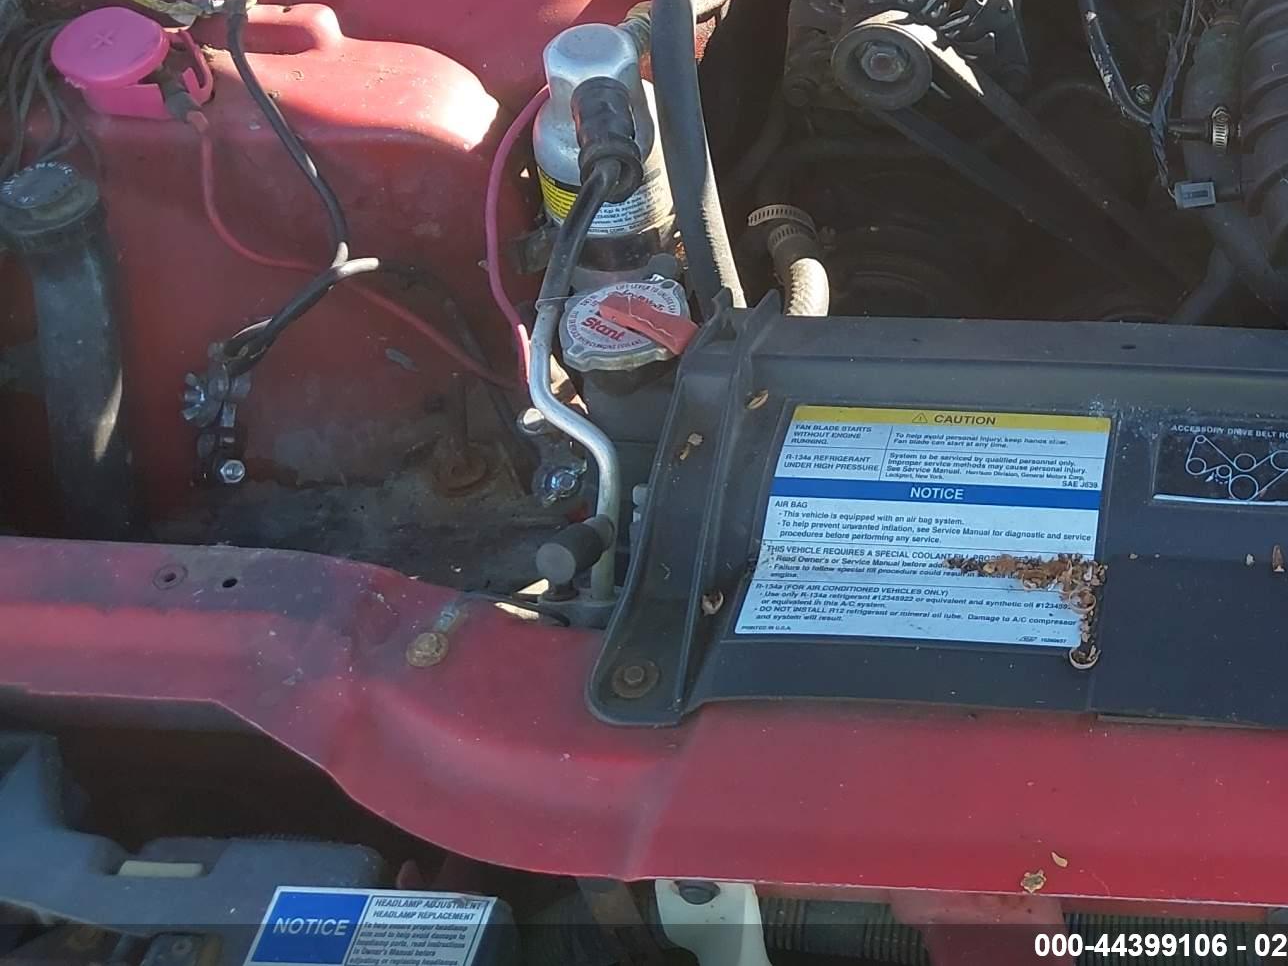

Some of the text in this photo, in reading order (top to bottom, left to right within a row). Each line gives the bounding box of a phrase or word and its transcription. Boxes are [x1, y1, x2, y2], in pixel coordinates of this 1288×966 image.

[583, 316, 624, 342] Stant
[933, 414, 996, 425] CAUTION
[1170, 424, 1225, 435] ACCESSORY
[1226, 428, 1254, 437] DRIVE
[1255, 429, 1277, 438] BELT
[813, 454, 871, 463] REFRIGERANT
[888, 452, 918, 461] System
[973, 455, 983, 463] by
[984, 456, 1017, 465] qualified
[1019, 457, 1056, 466] personnel
[834, 463, 879, 471] PRESSURE
[887, 459, 922, 468] Improper
[952, 461, 985, 469] methods
[1029, 464, 1062, 474] personal
[901, 465, 931, 473] Service
[909, 486, 964, 500] NOTICE
[838, 512, 875, 522] equipped
[917, 515, 933, 524] bag
[779, 529, 824, 539] procedures
[825, 531, 850, 539] before
[851, 532, 894, 542] performing
[895, 535, 909, 543] any
[791, 521, 809, 529] help
[810, 521, 840, 530] prevent
[841, 523, 879, 531] unwanted
[931, 527, 960, 535] Service
[962, 528, 990, 536] Manual
[991, 529, 1003, 537] for
[1004, 530, 1045, 539] diagnostic
[1063, 532, 1091, 540] service
[785, 545, 821, 554] VEHICLE
[822, 547, 865, 556] REQUIRES
[866, 548, 873, 556] A
[874, 549, 909, 558] SPECIAL
[841, 557, 870, 565] Service
[805, 583, 820, 591] AIR
[821, 584, 879, 594] CONDITIONED
[880, 586, 922, 595] VEHICLES
[374, 898, 422, 908] HEADLAMP
[372, 909, 475, 920] HEADLAMP REPLACEMENT
[272, 916, 350, 936] NOTICE
